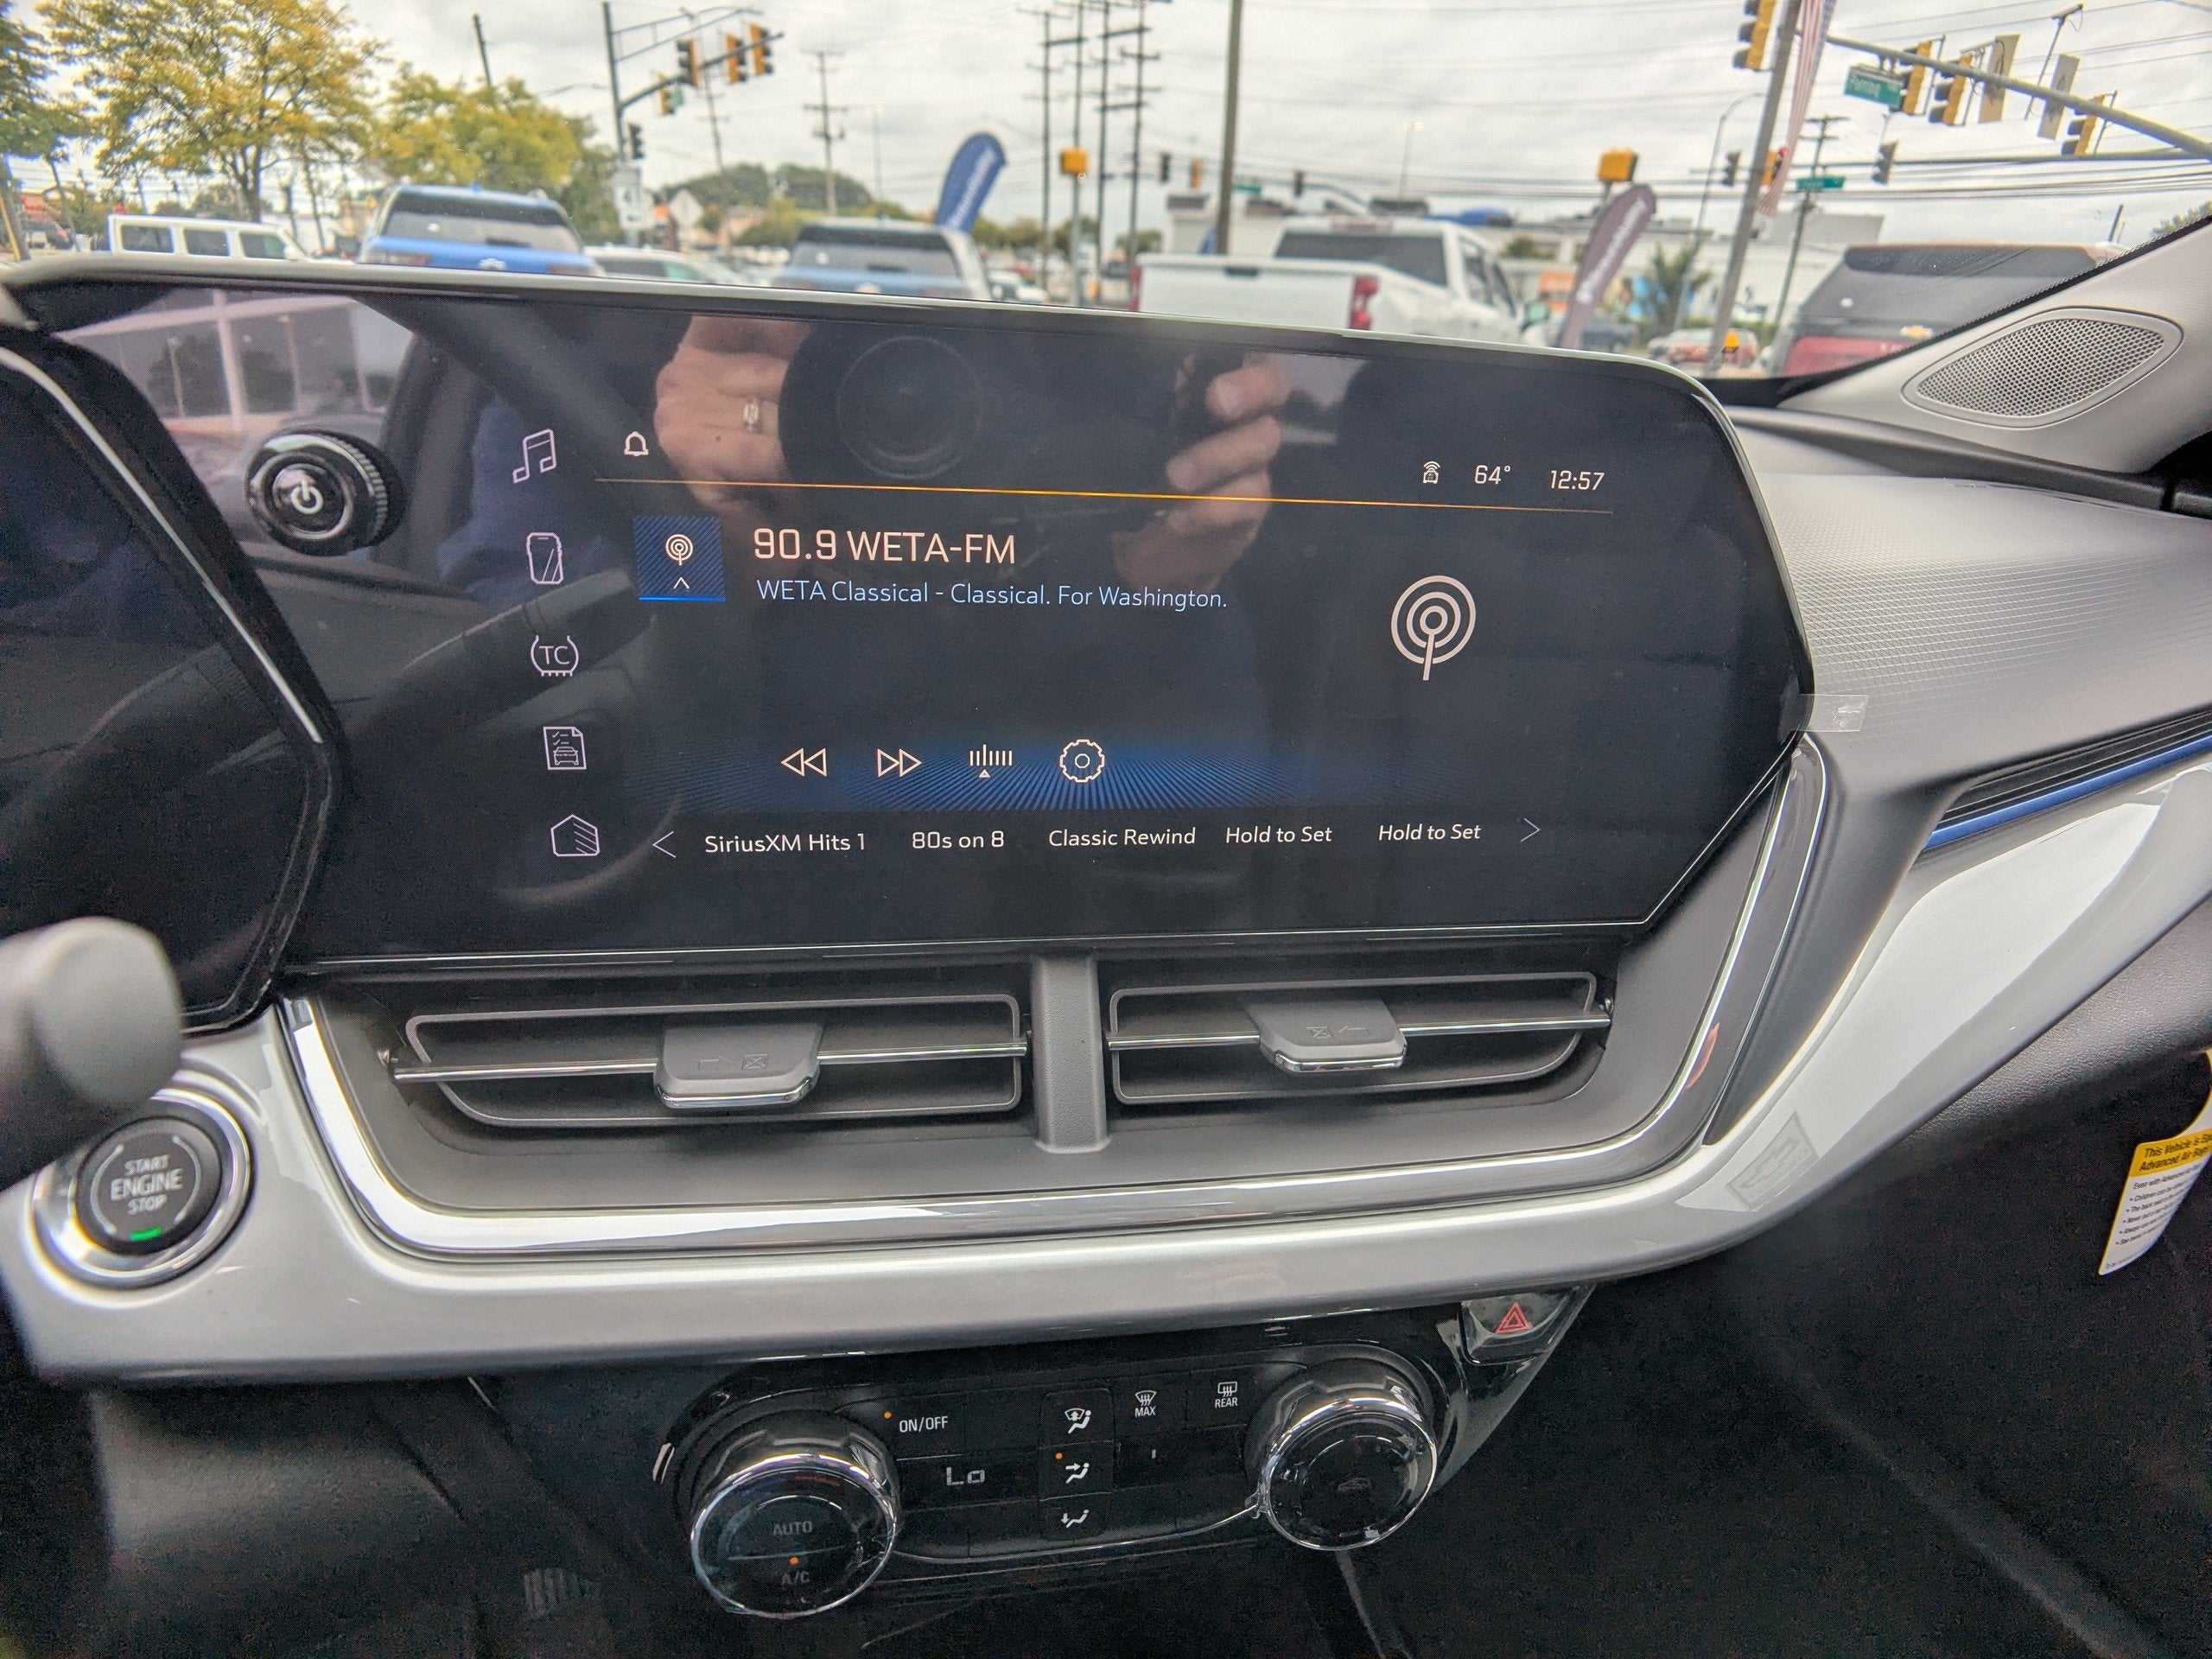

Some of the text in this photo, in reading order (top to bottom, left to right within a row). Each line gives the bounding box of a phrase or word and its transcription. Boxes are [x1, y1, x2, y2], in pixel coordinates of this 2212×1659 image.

[1550, 469, 1605, 491] 12:57
[753, 528, 1015, 564] 90.9 WETA-FM
[757, 579, 826, 601] WETA
[831, 581, 928, 602] Classical
[950, 583, 1051, 605] Classical.
[1058, 585, 1093, 605] For
[1099, 586, 1227, 612] Washington.
[538, 645, 570, 665] TC
[912, 830, 1005, 849] 80s on 8
[1048, 827, 1196, 847] Classic Rewind
[1225, 825, 1333, 844] Hold to Set
[1378, 823, 1482, 842] Hold to Set
[704, 832, 865, 853] SiriusXM Hits 1
[2144, 1147, 2163, 1159] This
[124, 1154, 169, 1176] START
[2139, 1154, 2181, 1172] Advanced
[110, 1167, 184, 1202] ENGINE
[127, 1193, 168, 1216] STOP
[1135, 1406, 1156, 1418] MAX
[1215, 1397, 1238, 1408] REAR
[899, 1415, 949, 1433] ON/OFF
[946, 1466, 985, 1486] Lo
[772, 1520, 812, 1537] AUTO
[781, 1570, 810, 1586] A/C
